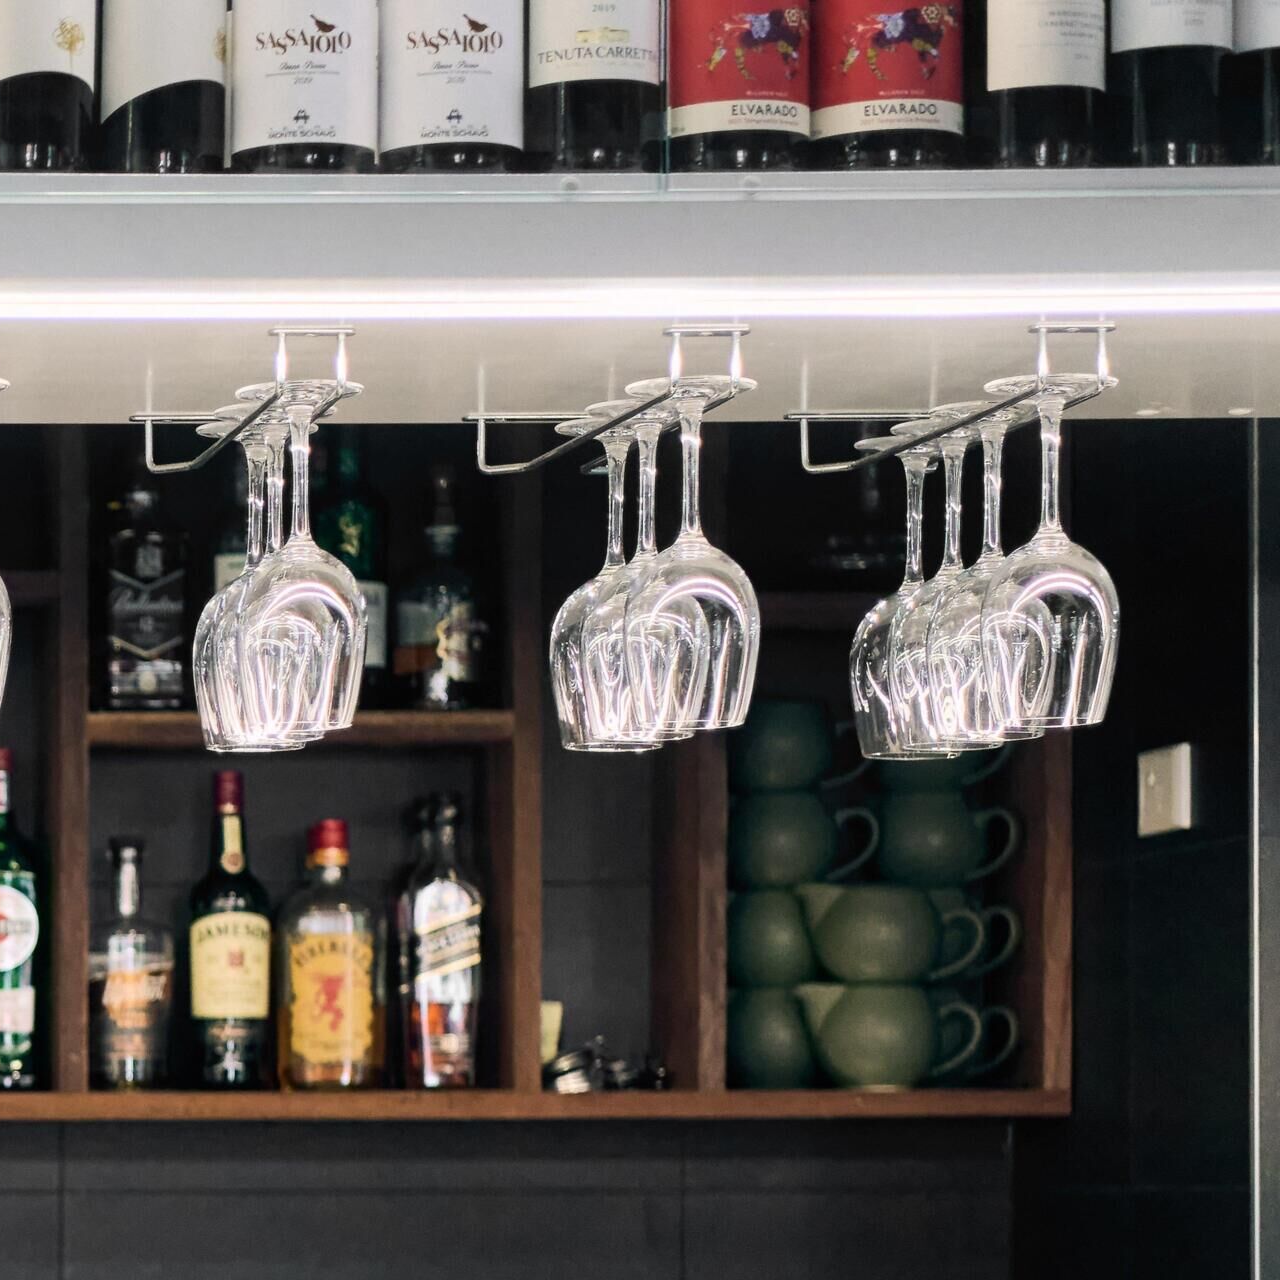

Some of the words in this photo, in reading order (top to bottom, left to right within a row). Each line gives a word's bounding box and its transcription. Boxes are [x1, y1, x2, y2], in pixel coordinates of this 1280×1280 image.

[537, 47, 593, 64] TENUTA
[731, 104, 798, 118] ELVARADO
[863, 103, 938, 117] ELVARADO
